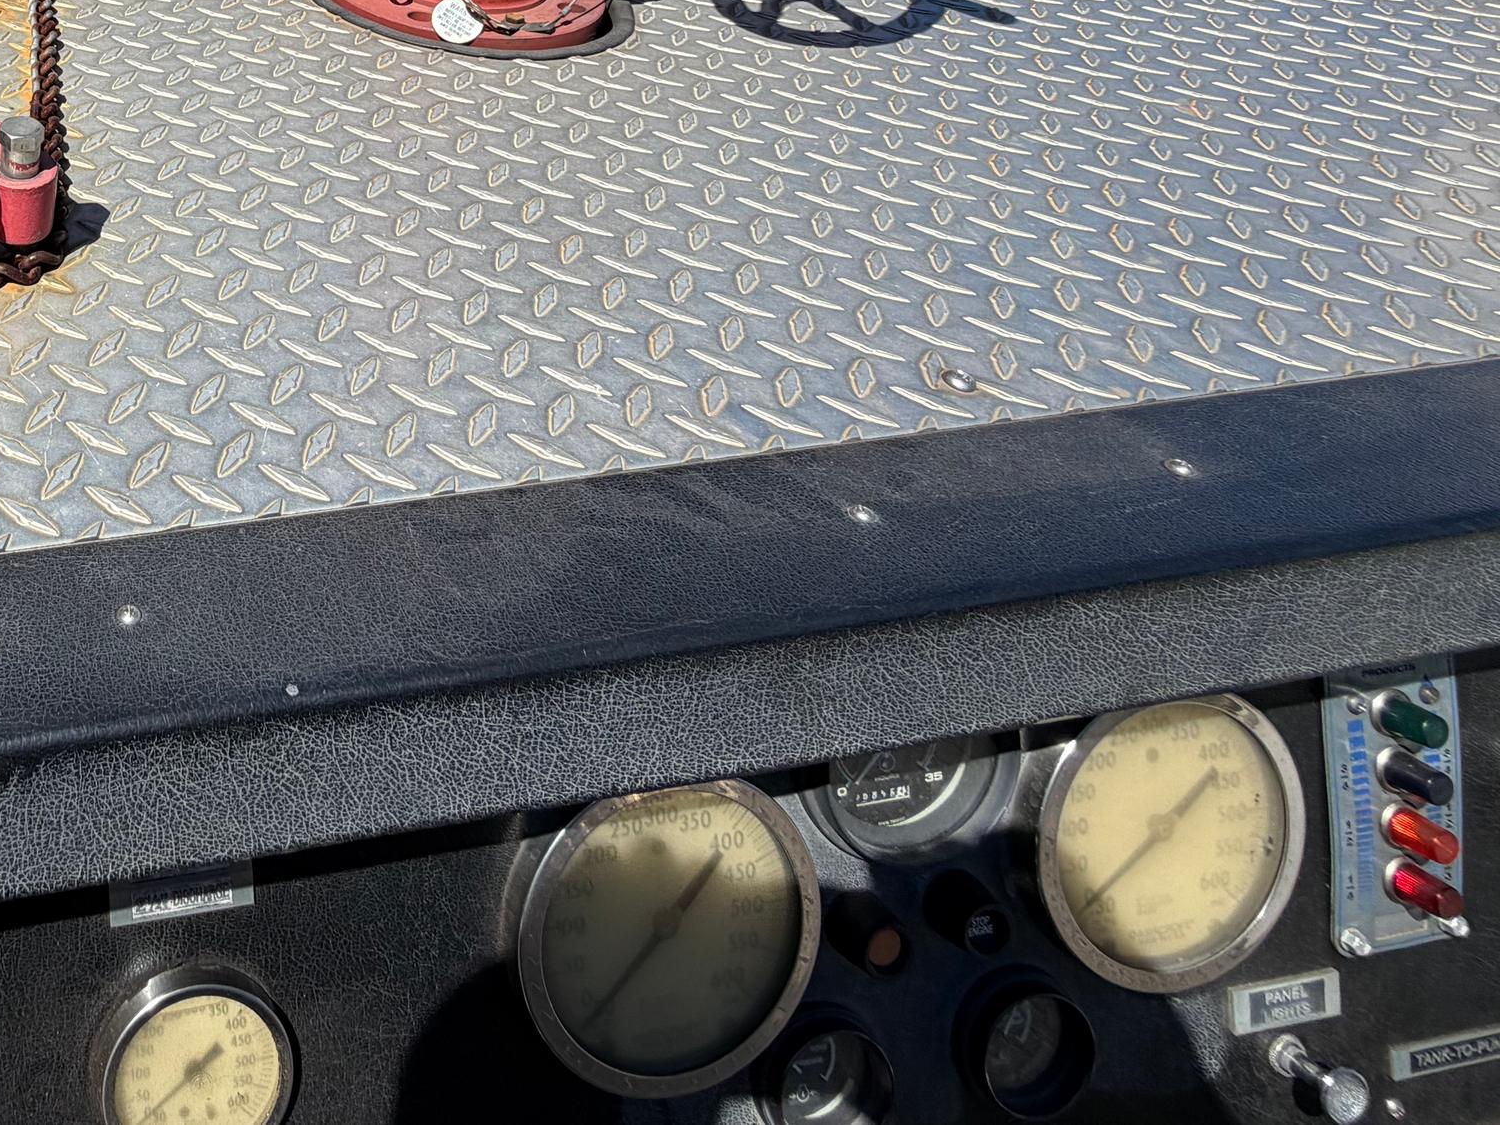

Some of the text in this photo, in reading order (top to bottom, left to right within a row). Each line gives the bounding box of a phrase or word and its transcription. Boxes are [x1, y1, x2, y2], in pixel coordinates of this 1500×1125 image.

[1171, 723, 1200, 741] 350
[1198, 741, 1230, 761] 400
[1087, 751, 1117, 772] 200
[924, 771, 943, 783] 35
[837, 787, 848, 798] 0
[610, 818, 643, 838] 250
[678, 810, 712, 832] 350
[710, 830, 745, 851] 400
[724, 861, 757, 882] 450
[971, 915, 990, 926] STOP
[968, 924, 994, 938] ENGINE
[1264, 986, 1309, 1005] PANEL
[209, 1003, 229, 1017] 350
[1261, 1002, 1312, 1022] LIGHTS
[225, 1016, 247, 1031] 400
[231, 1034, 252, 1047] 450
[235, 1054, 256, 1069] 500
